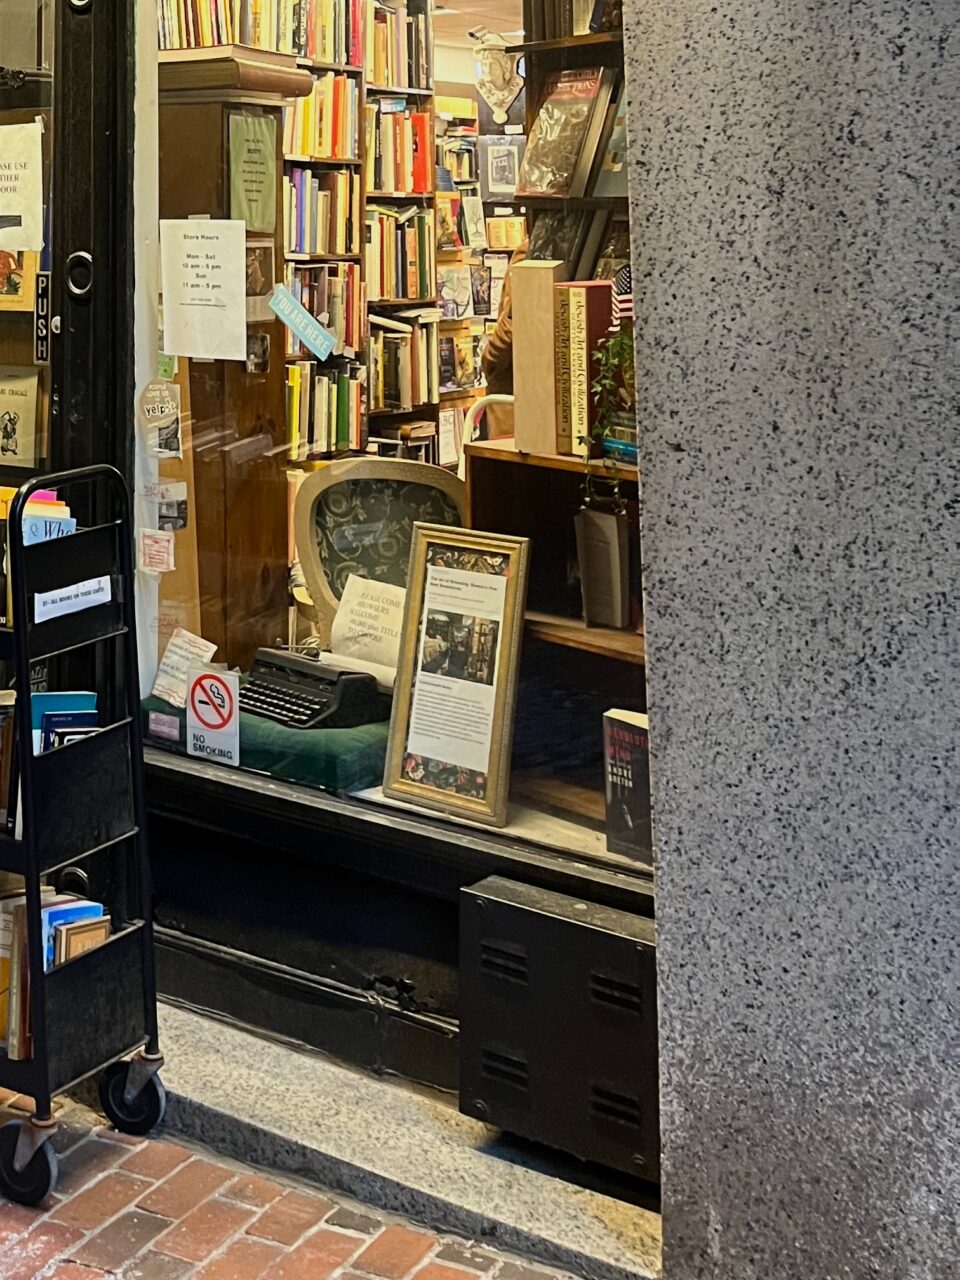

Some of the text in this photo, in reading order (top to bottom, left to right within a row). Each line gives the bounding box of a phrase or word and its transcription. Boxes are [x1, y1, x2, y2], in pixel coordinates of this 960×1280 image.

[14, 161, 28, 170] USE
[37, 276, 48, 359] PUSH
[275, 292, 331, 355] YOU ARE HERE
[576, 334, 585, 351] Art
[560, 351, 569, 368] and
[576, 352, 585, 369] and
[560, 368, 569, 424] Civilization
[576, 369, 585, 426] Civilization
[144, 402, 167, 418] yelp
[381, 597, 401, 608] COME
[192, 733, 206, 744] NO
[192, 742, 233, 760] SMOKING
